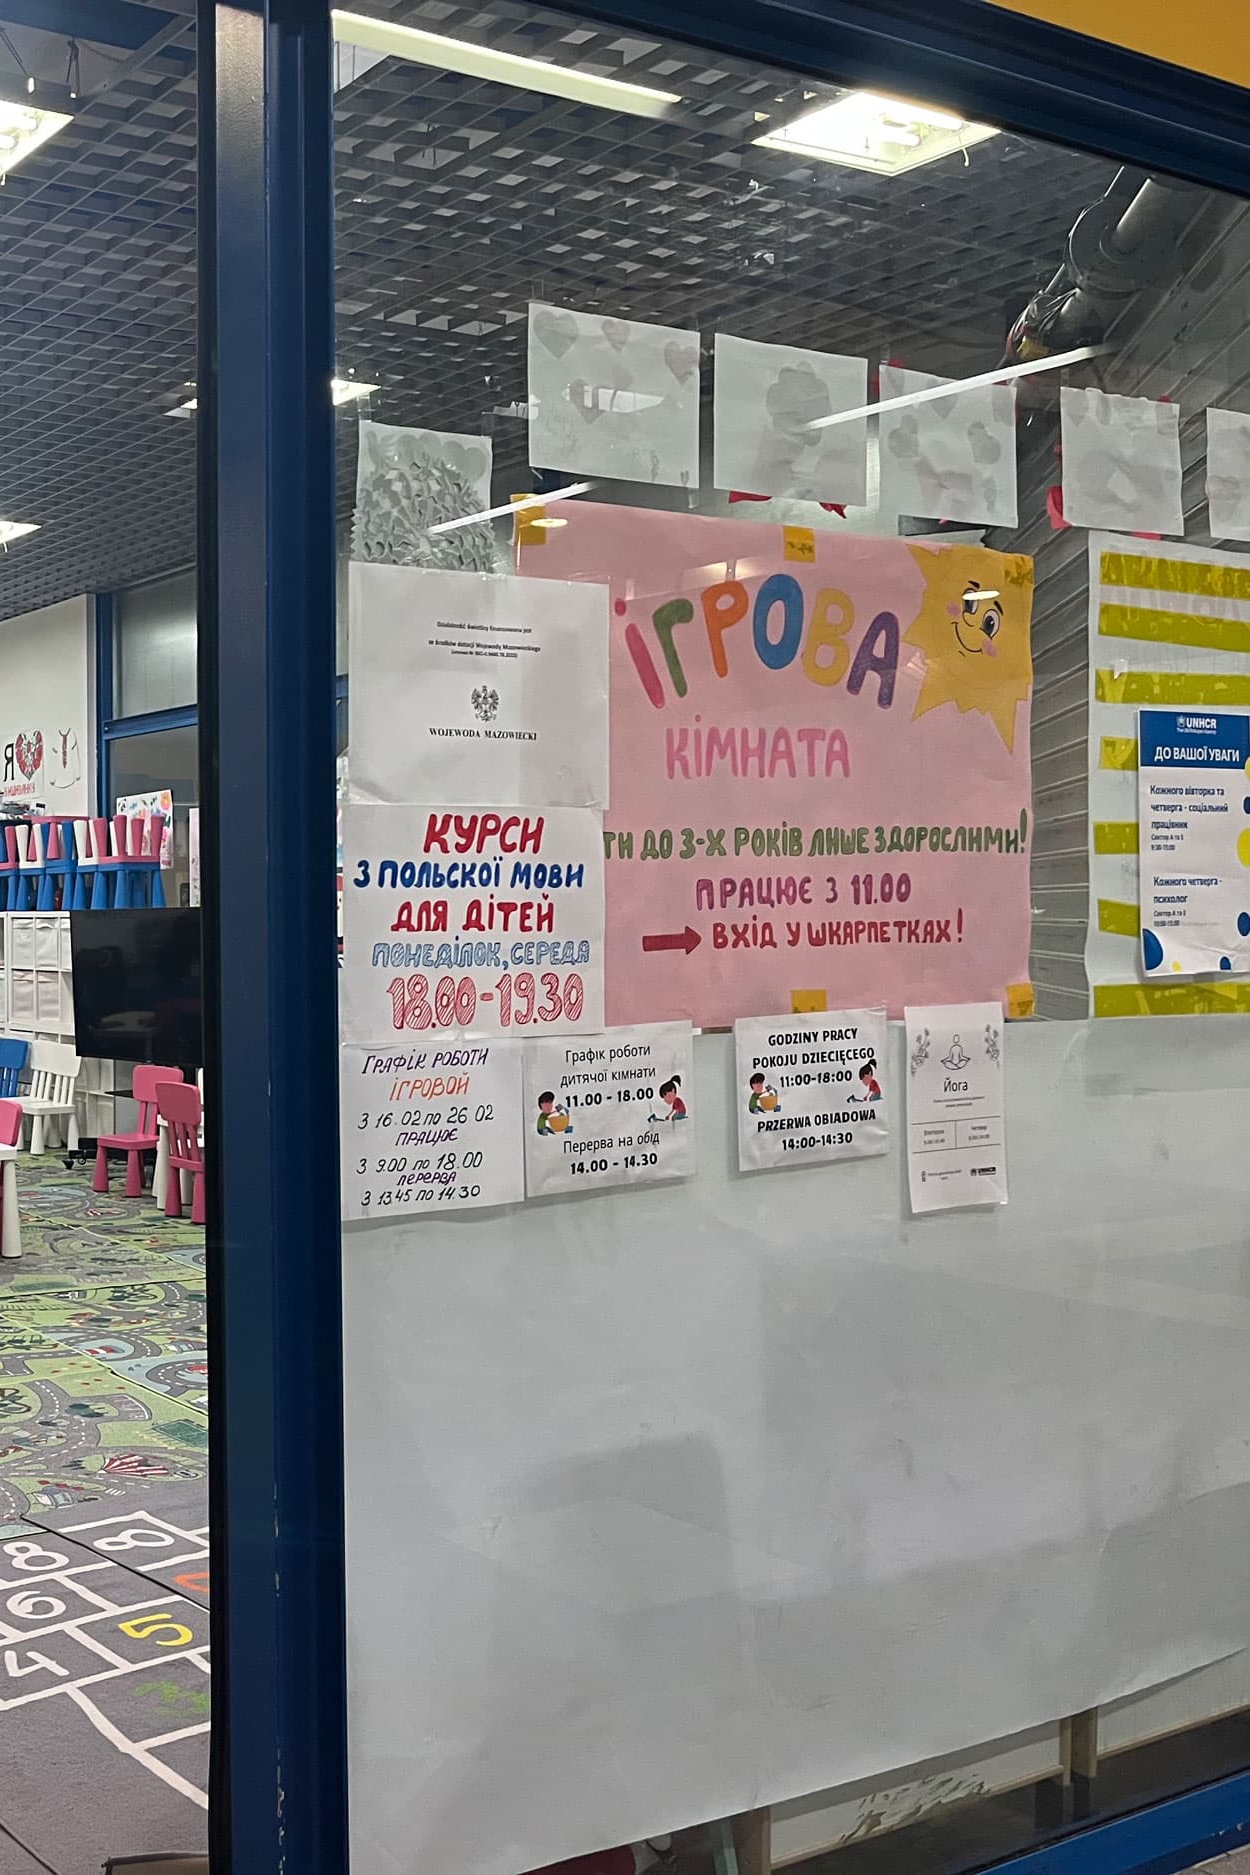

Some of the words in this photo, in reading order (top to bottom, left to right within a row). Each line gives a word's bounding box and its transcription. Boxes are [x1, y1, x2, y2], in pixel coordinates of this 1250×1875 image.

[614, 573, 899, 710] ІГРОВА
[429, 727, 481, 738] WOJEWODA
[484, 730, 537, 741] MAZOWIECKI
[1186, 717, 1217, 729] UNHCR
[666, 714, 851, 780] КІМНАТА
[1154, 746, 1172, 762] ДО
[1173, 745, 1208, 761] ВАШОЇ
[1208, 748, 1240, 762] УВАГИ
[1150, 784, 1183, 796] Кожного
[1150, 804, 1183, 814] четверга
[1189, 802, 1229, 814] соціальний
[423, 813, 545, 855] КУРСИ
[640, 829, 673, 861] ДО
[734, 821, 803, 857] РОКІВ
[808, 827, 870, 857] ЛИШЕ
[353, 859, 371, 889] З
[378, 856, 503, 889] ПОЛЬСКОЇ
[510, 861, 585, 890] МОВИ
[1153, 876, 1187, 887] Кожного
[1188, 878, 1218, 887] четверга
[696, 875, 813, 911] ПРАЦЮЄ
[851, 872, 912, 905] 11.00
[1153, 895, 1188, 904] психолог
[391, 899, 448, 932] ДЛЯ
[462, 893, 555, 933] ДІТЕЙ
[712, 914, 777, 949] ВХІД
[786, 921, 801, 947] У
[768, 1031, 818, 1046] GODZINY
[822, 1028, 858, 1042] PRACY
[362, 1049, 426, 1074] ГРАФІК
[432, 1048, 489, 1068] РОБОТИ
[566, 1048, 605, 1066] Графік
[610, 1045, 651, 1062] роботи
[752, 1054, 798, 1070] POKOJU
[802, 1047, 875, 1066] DZIECIĘCEGO
[389, 1072, 470, 1101] ІГРОВОЙ
[560, 1069, 608, 1088] дитячої
[612, 1066, 656, 1081] кімнати
[779, 1070, 853, 1088] 11:00-18:00
[944, 1077, 968, 1093] Йога
[565, 1093, 602, 1107] 11.00
[617, 1088, 654, 1103] 18.00
[757, 1116, 811, 1133] PRZERWA
[814, 1109, 877, 1127] OBIADOWA
[395, 1128, 459, 1147] ПРАЦЮЄ
[563, 1138, 613, 1154] Перерва
[618, 1135, 633, 1147] на
[637, 1131, 660, 1145] обід
[781, 1132, 853, 1151] 14:00-14:30
[376, 1157, 407, 1173] 9.00
[436, 1151, 483, 1170] 18.00
[571, 1159, 608, 1175] 14.00
[624, 1153, 658, 1169] 14.30
[438, 1185, 481, 1201] 14.30
[93, 1528, 175, 1551] 8
[3, 1541, 70, 1571] 8
[6, 1590, 67, 1619] 6
[4, 1650, 70, 1677] 4
[118, 1613, 194, 1647] 5
